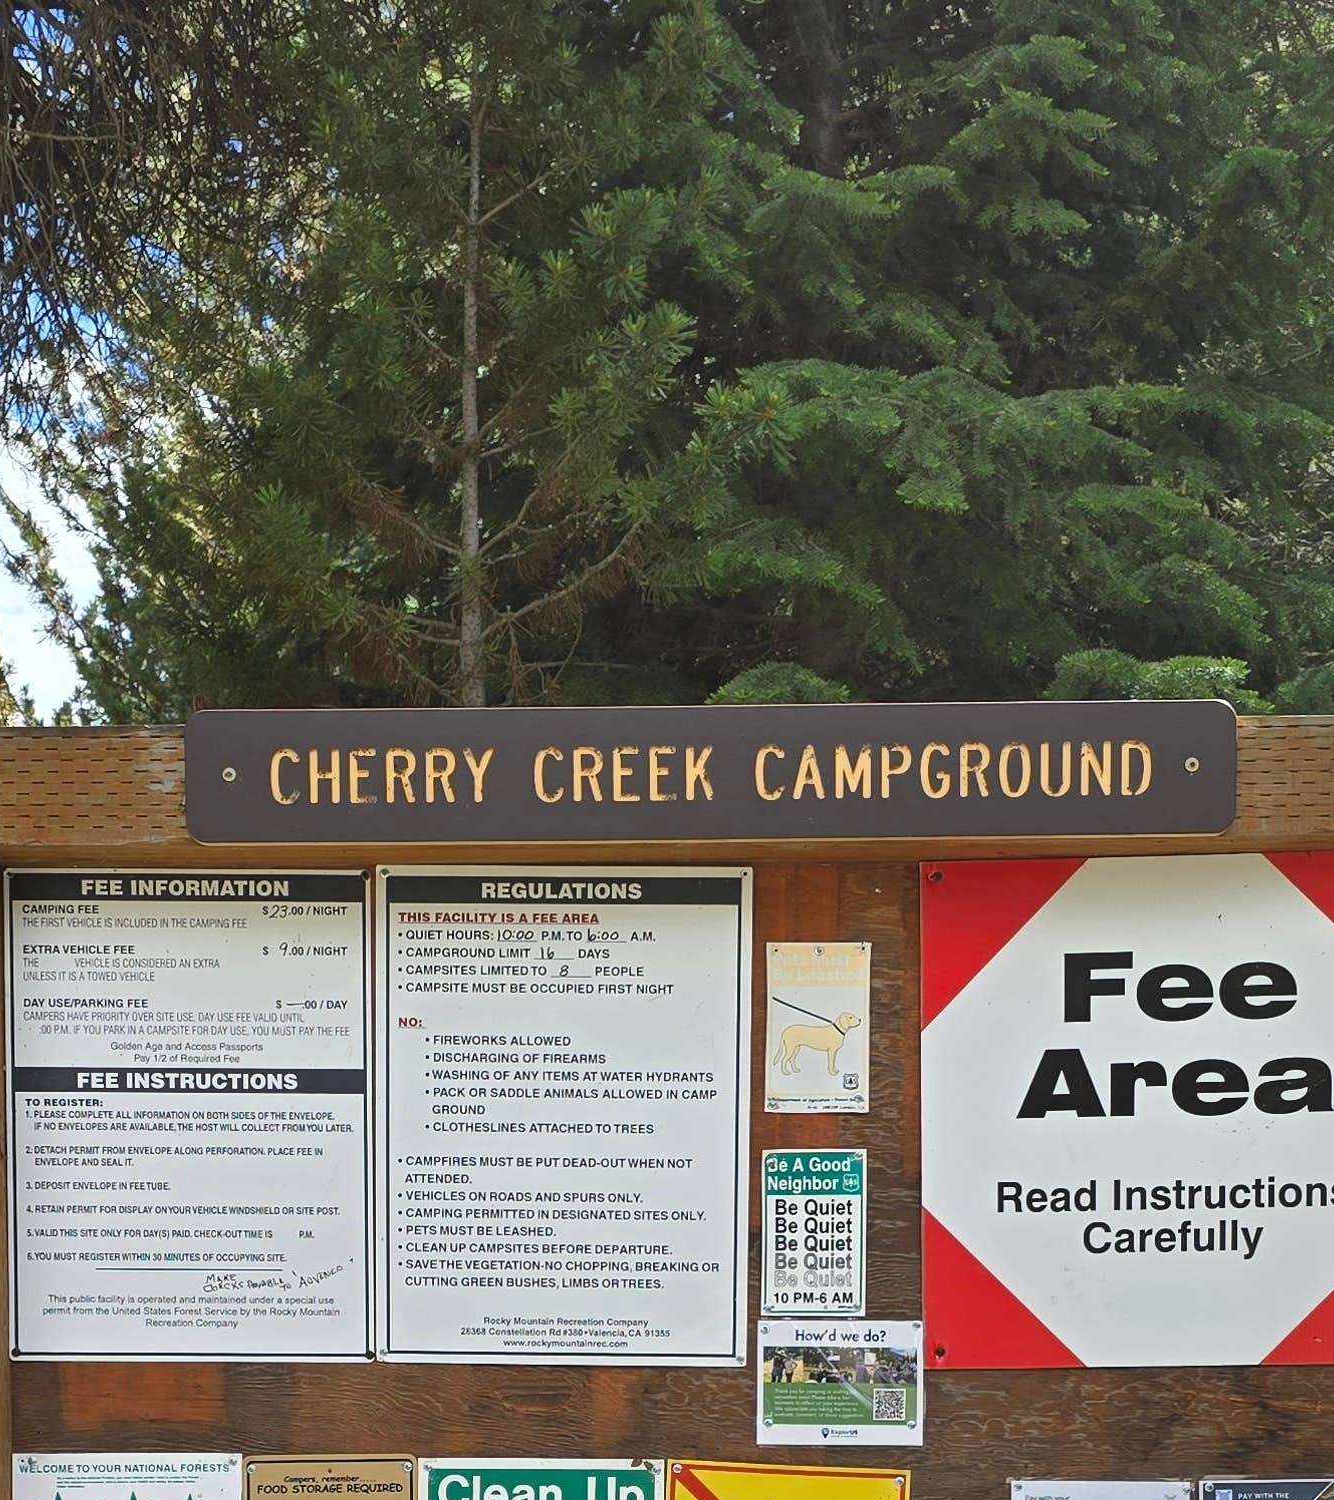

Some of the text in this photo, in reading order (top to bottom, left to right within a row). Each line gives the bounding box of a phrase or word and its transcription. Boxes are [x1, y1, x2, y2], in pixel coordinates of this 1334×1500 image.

[268, 740, 1153, 804] CHERRY CREEK CAMPGROUND
[81, 880, 289, 896] FEE INFORMATION
[481, 883, 642, 899] REGULATIONS
[23, 905, 99, 914] CAMPING FEE
[313, 906, 348, 916] NIGHT
[399, 912, 599, 924] THIS FACILITY IS A FEE AREA
[406, 930, 442, 941] QUIET
[446, 931, 494, 940] HOURS:
[541, 932, 565, 941] P.M.
[567, 932, 582, 941] TO
[631, 932, 655, 941] A.M.
[23, 945, 135, 954] EXTRA VEHICLE FEE
[406, 948, 495, 958] CAMPGROUND
[499, 949, 530, 958] LIMIT
[579, 949, 610, 959] DAYS
[406, 966, 476, 976] CAMPSITES
[480, 966, 529, 976] LIMITED
[531, 966, 547, 976] TO
[595, 967, 644, 977] PEOPLE
[1064, 952, 1298, 1023] Fee
[23, 999, 148, 1008] DAY USE/PARKING FEE
[398, 1018, 423, 1028] NO:
[111, 1042, 263, 1053] Golden Age and Access Passports
[433, 1036, 571, 1046] FIREWORKS ALLOWED
[77, 1073, 298, 1090] FEE INSTRUCTIONS
[1016, 1048, 1334, 1119] Area
[793, 1157, 804, 1172] A
[809, 1157, 851, 1172] Good
[768, 1176, 838, 1192] Neighbor
[996, 1181, 1097, 1213] Read
[775, 1199, 852, 1216] Be Quiet
[775, 1217, 852, 1234] Be Quiet
[775, 1235, 852, 1252] Be Quiet
[1083, 1219, 1264, 1259] Carefully
[775, 1253, 852, 1270] Be Quiet
[775, 1271, 852, 1288] Be Quiet
[774, 1293, 853, 1303] 10 PM-6 AM
[841, 1330, 859, 1342] we
[864, 1330, 887, 1342] do?
[19, 1464, 229, 1473] WELCOME TO YOUR NATIONAL FORESTS
[257, 1484, 403, 1494] FOOD STORAGE REQUIRED
